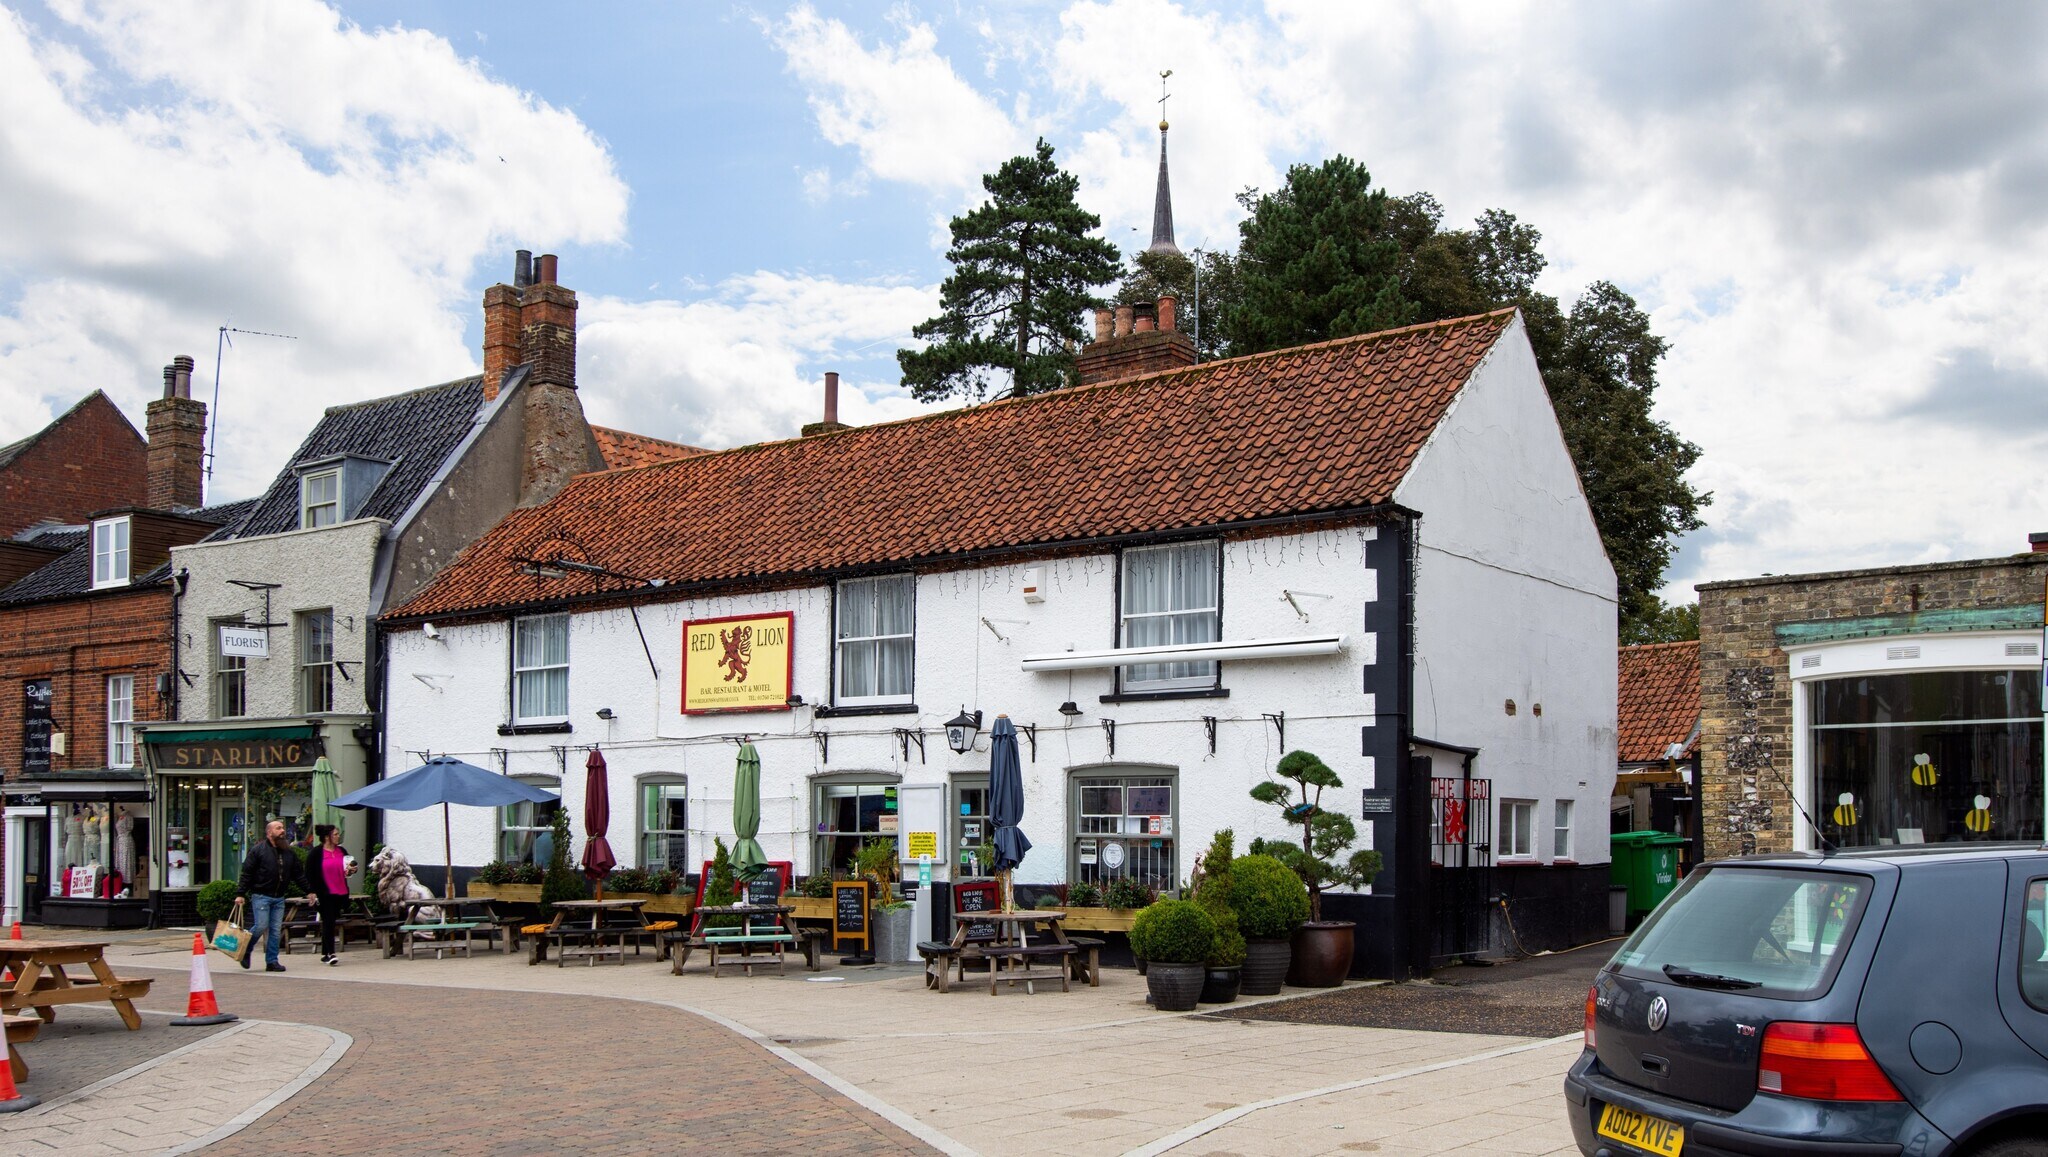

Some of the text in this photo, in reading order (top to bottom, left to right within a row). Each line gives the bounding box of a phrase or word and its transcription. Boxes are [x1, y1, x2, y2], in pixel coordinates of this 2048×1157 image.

[225, 637, 265, 648] FLORIST
[691, 627, 785, 652] RED LION
[26, 685, 53, 701] Raffles
[713, 685, 747, 695] RESTAURANT
[753, 684, 771, 692] MOTEL
[175, 744, 301, 766] STARLING
[1430, 778, 1487, 799] THE RED
[73, 877, 84, 888] 50%
[84, 875, 93, 887] OFF
[1656, 872, 1672, 884] Viridor
[1736, 1023, 1756, 1037] TDI
[1641, 1118, 1679, 1151] KVE
